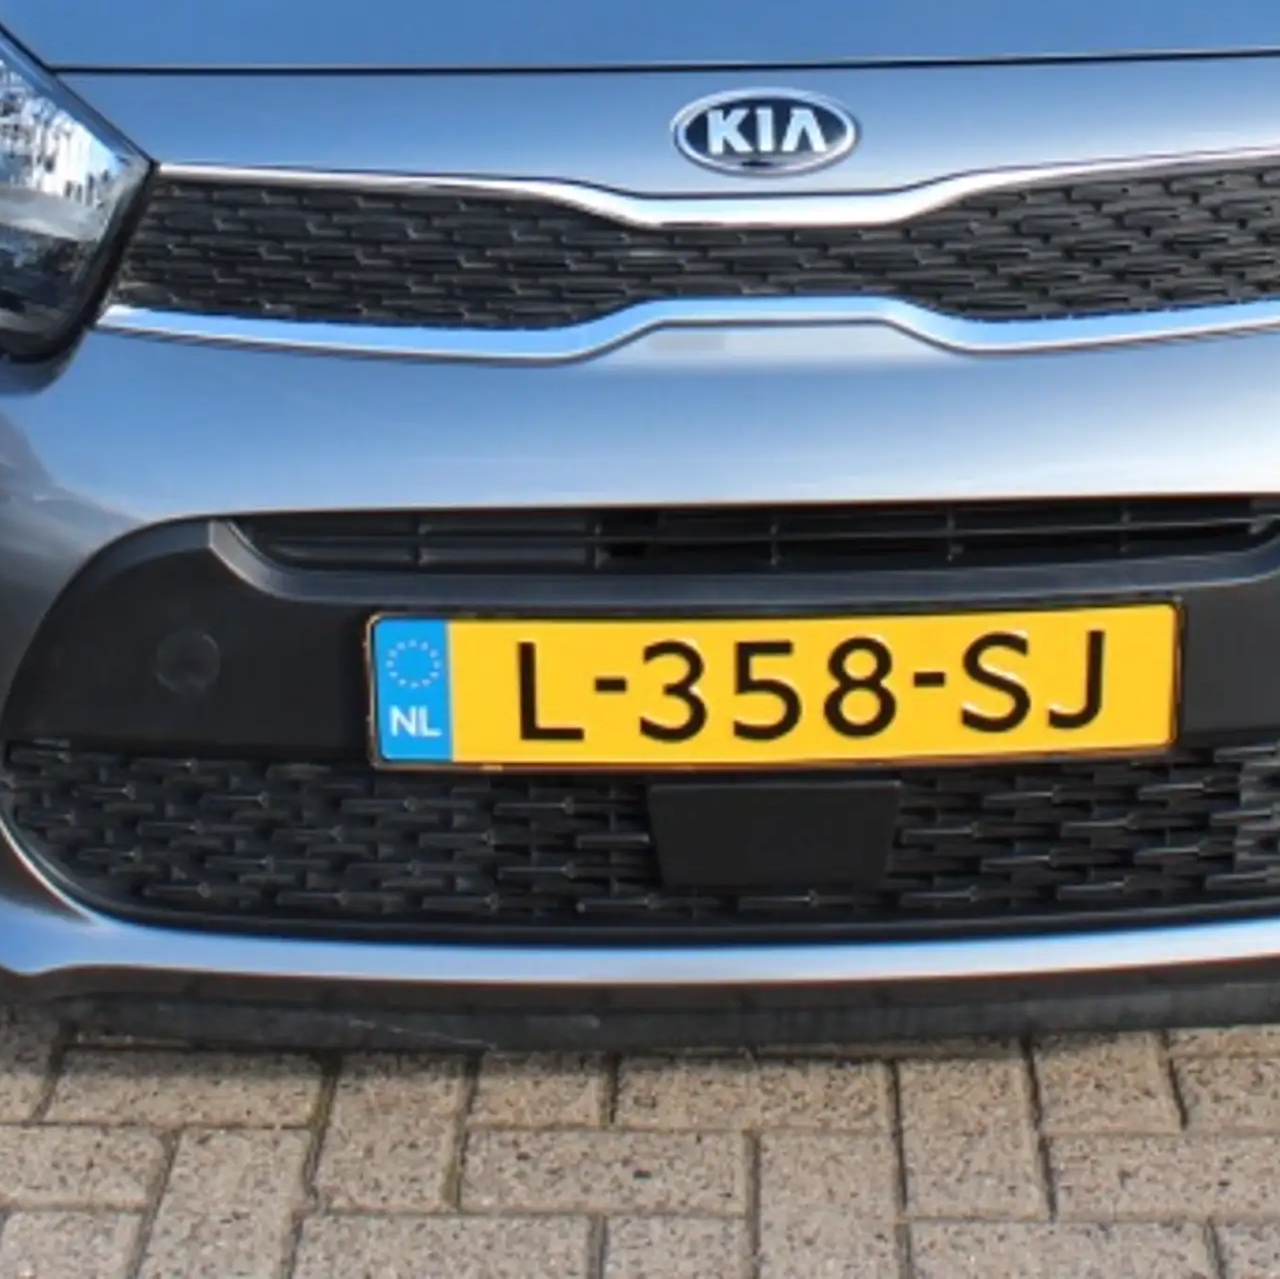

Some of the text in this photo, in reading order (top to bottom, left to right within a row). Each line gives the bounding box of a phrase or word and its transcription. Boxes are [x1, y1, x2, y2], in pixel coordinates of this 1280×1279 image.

[707, 106, 828, 155] KIA
[518, 629, 1108, 744] L-358-SJ
[389, 704, 443, 738] NL
